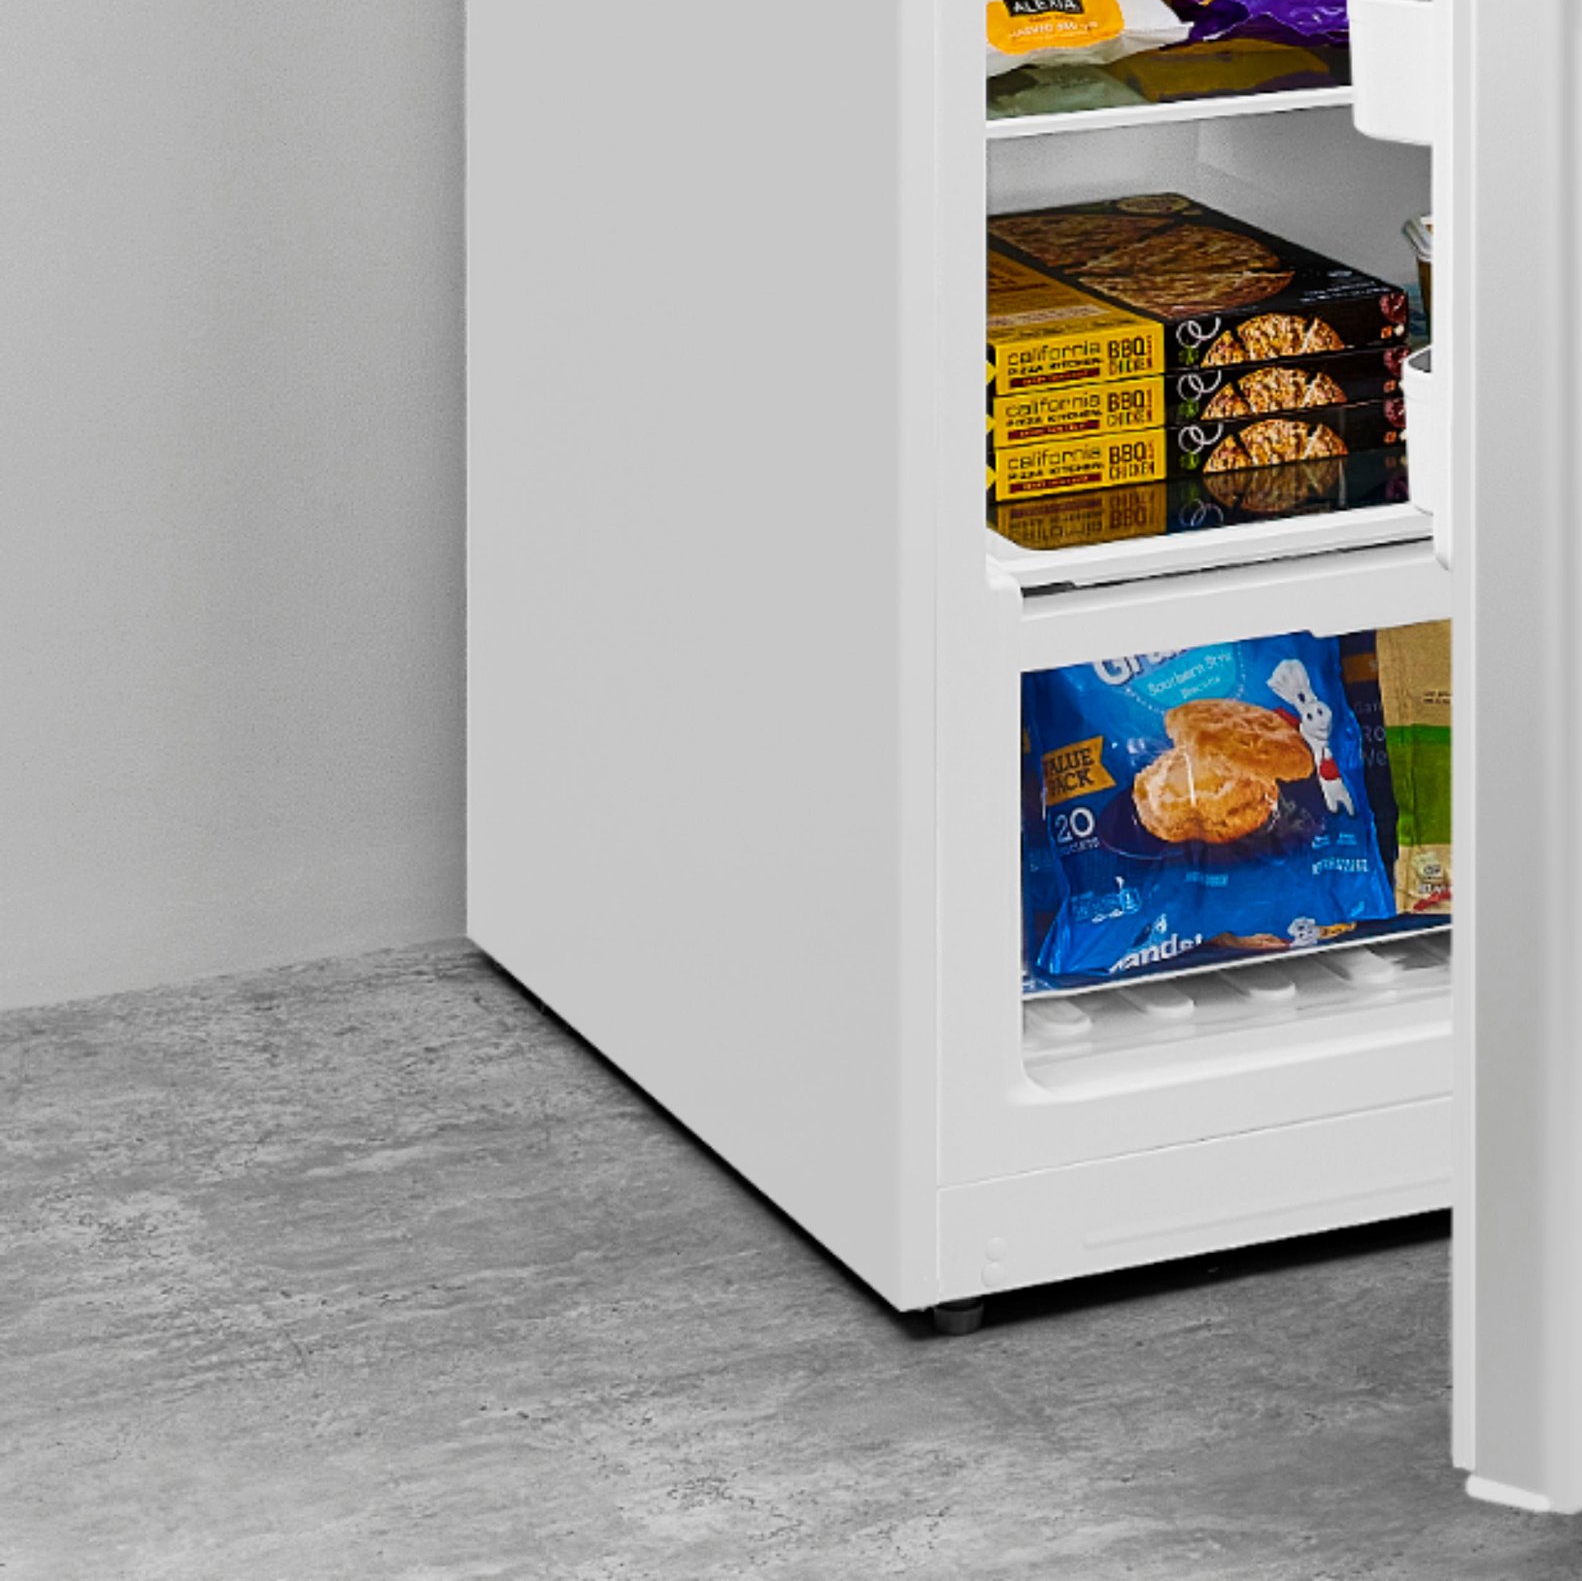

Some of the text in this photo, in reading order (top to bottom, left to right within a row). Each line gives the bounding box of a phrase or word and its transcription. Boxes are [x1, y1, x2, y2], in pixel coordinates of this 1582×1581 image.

[1008, 340, 1101, 366] california
[1109, 336, 1146, 359] BBQ
[1006, 392, 1101, 418] california
[1108, 389, 1146, 412] BBQ
[1008, 444, 1101, 470] california
[1109, 441, 1147, 465] BBQ
[1055, 807, 1095, 843] 20
